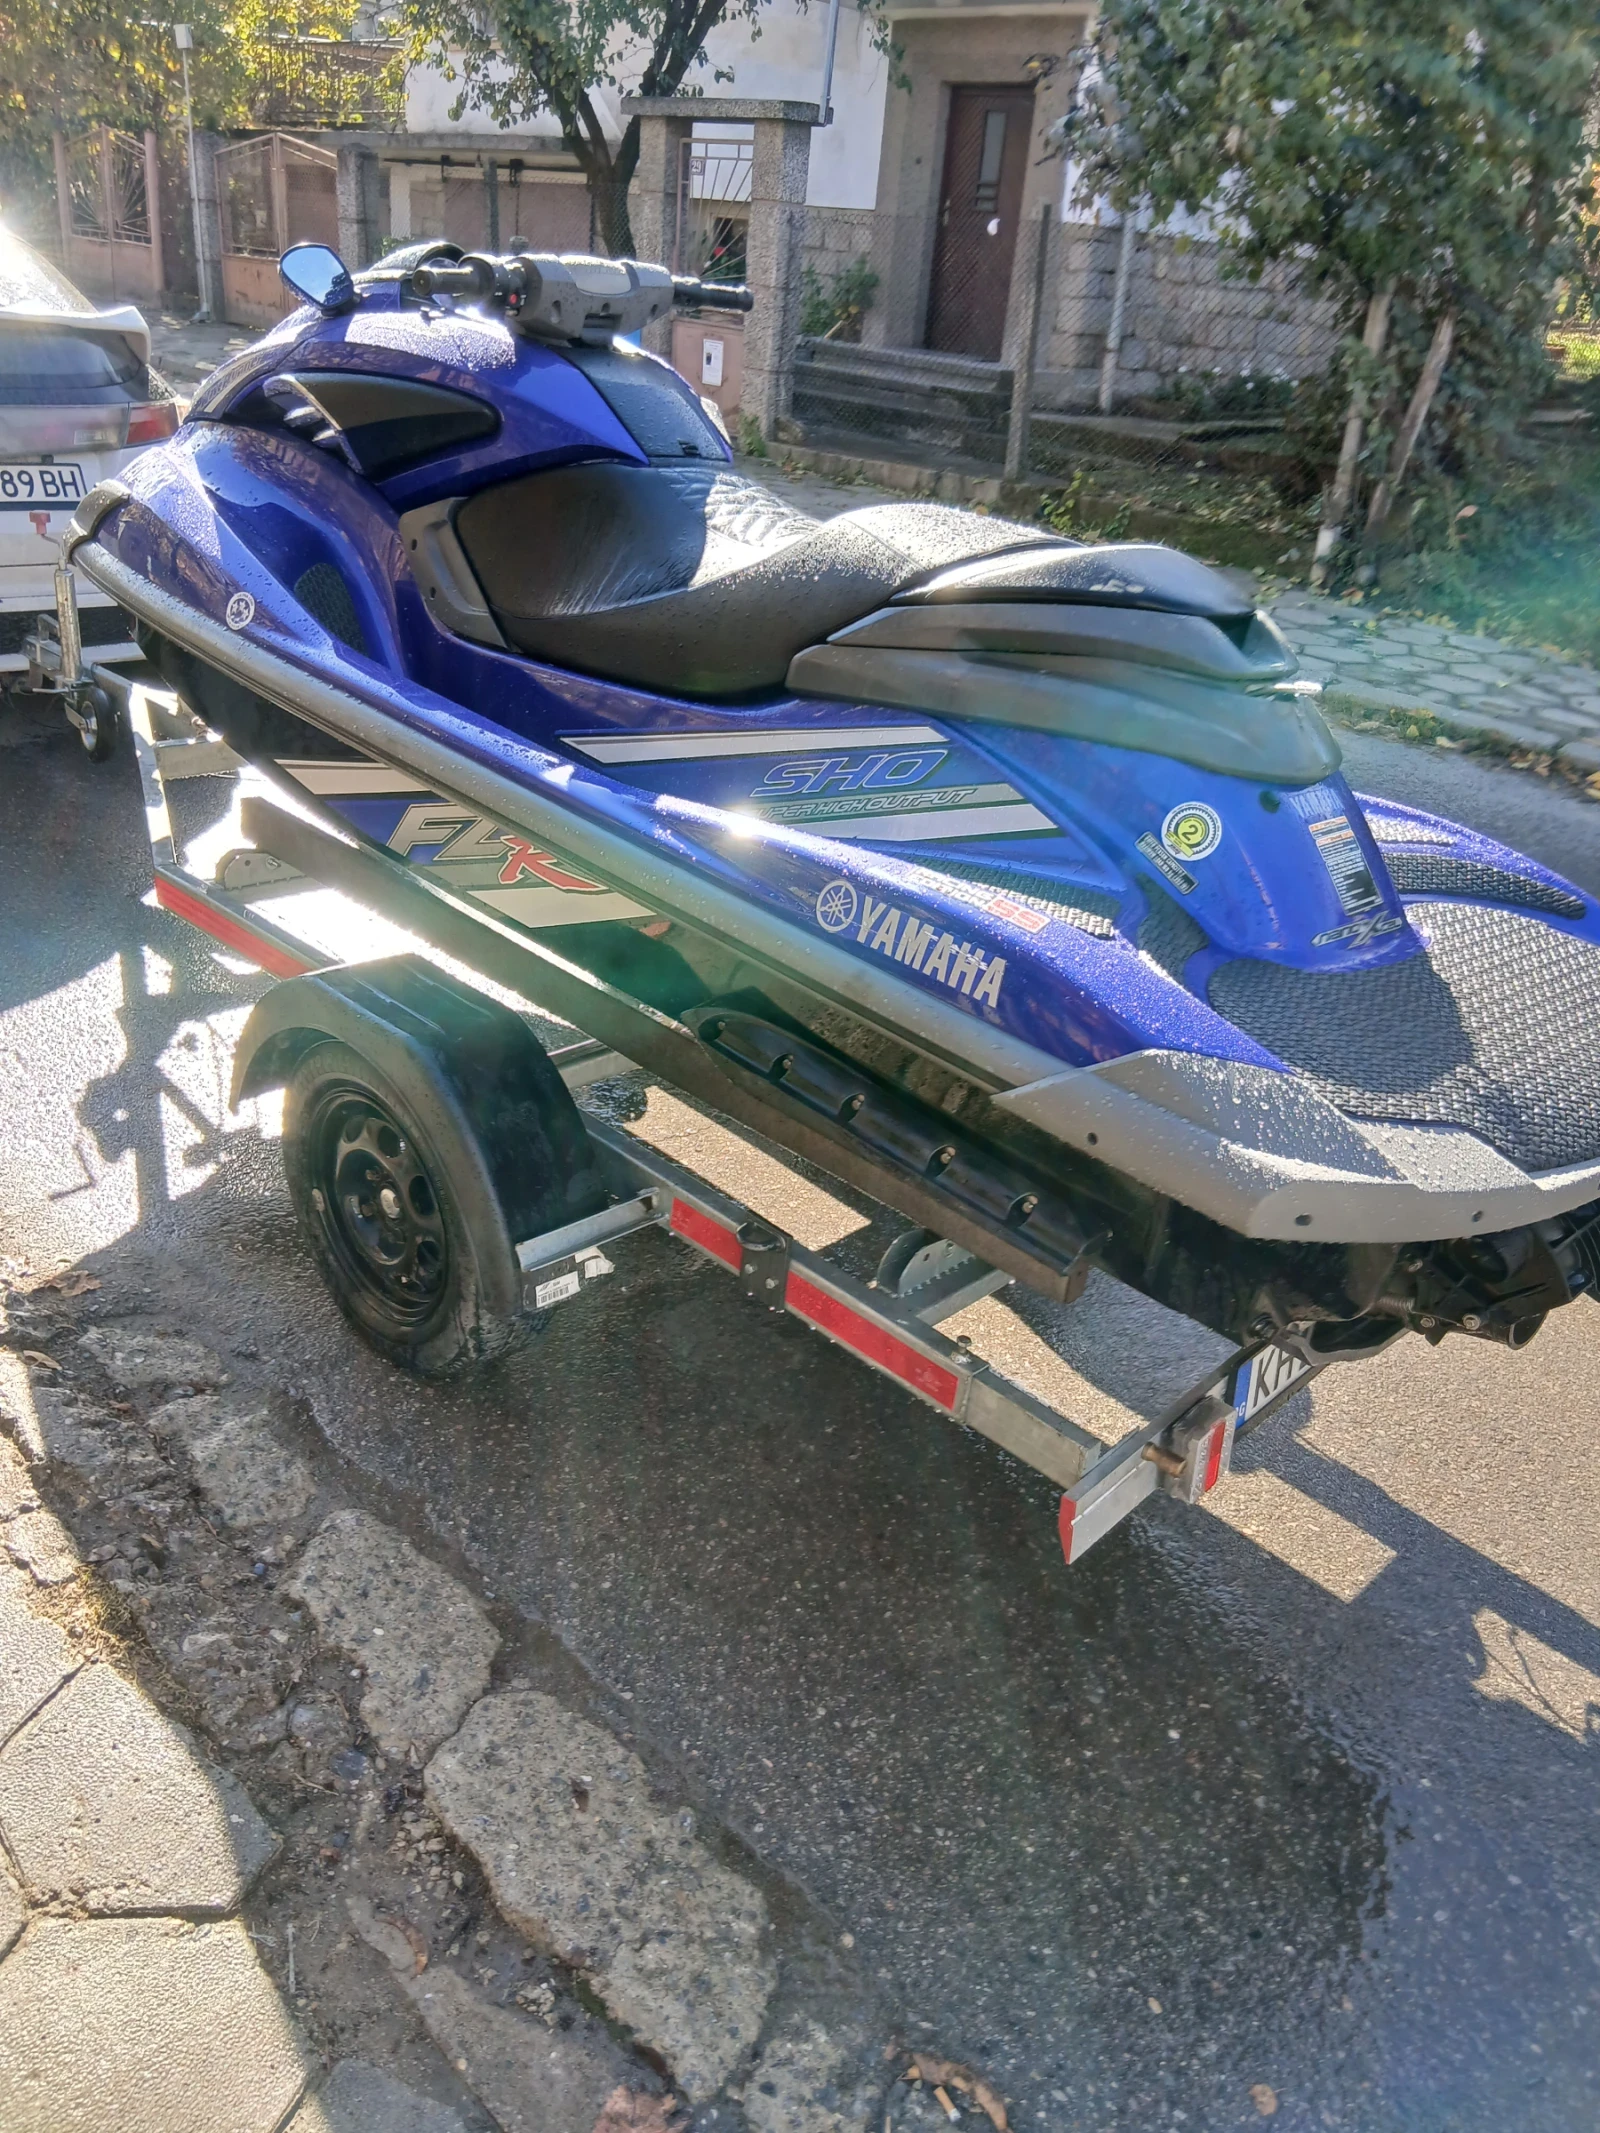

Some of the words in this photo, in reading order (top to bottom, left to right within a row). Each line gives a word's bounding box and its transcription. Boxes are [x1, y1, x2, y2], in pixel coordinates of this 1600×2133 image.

[39, 470, 81, 498] BH
[750, 749, 948, 798] SHO
[813, 799, 867, 816] HIGH
[865, 788, 976, 812] OUTPUT
[1181, 824, 1199, 842] 2
[856, 895, 1008, 1009] YAMAHA
